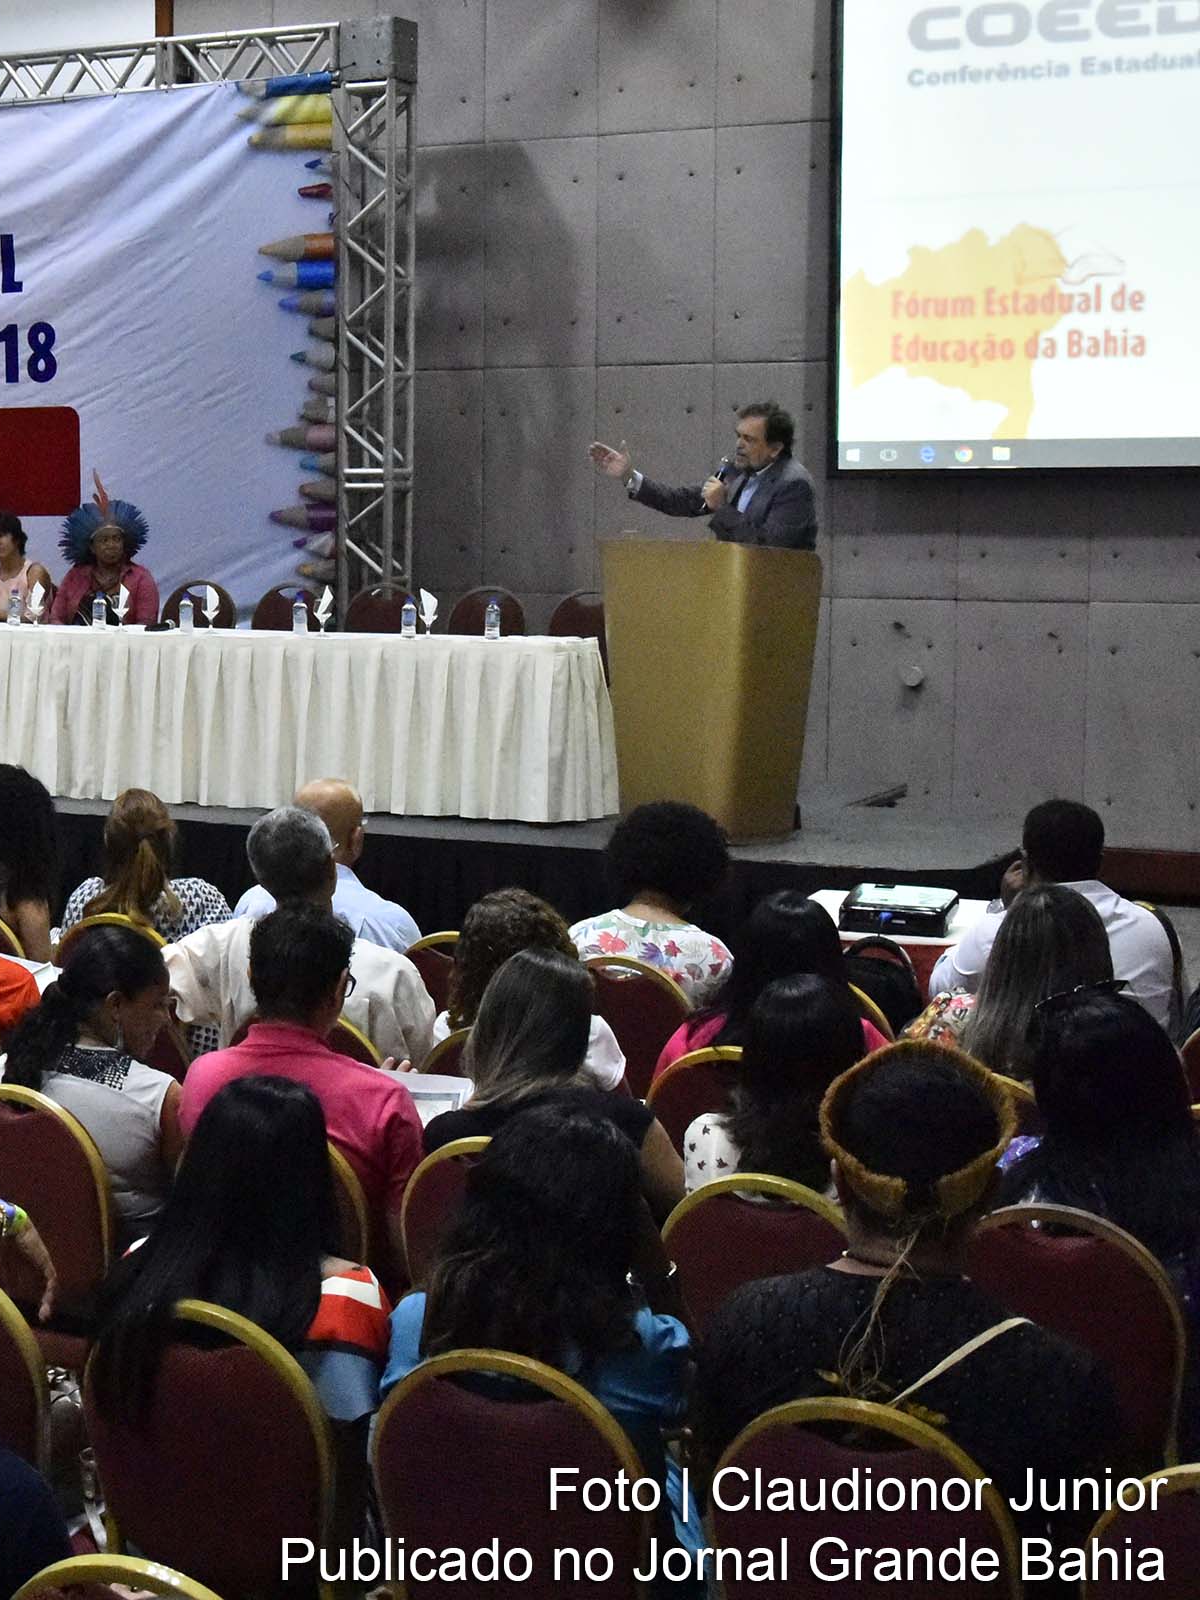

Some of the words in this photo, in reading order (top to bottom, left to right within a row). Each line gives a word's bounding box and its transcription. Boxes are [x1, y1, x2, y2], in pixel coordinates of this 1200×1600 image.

[907, 60, 1071, 88] Conferência
[1081, 52, 1200, 75] Estadual
[891, 288, 976, 319] Fórum
[984, 283, 1102, 317] Estadual
[1111, 282, 1146, 313] de
[890, 330, 1015, 368] Educação
[1024, 329, 1057, 360] da
[1066, 327, 1147, 358] Bahia
